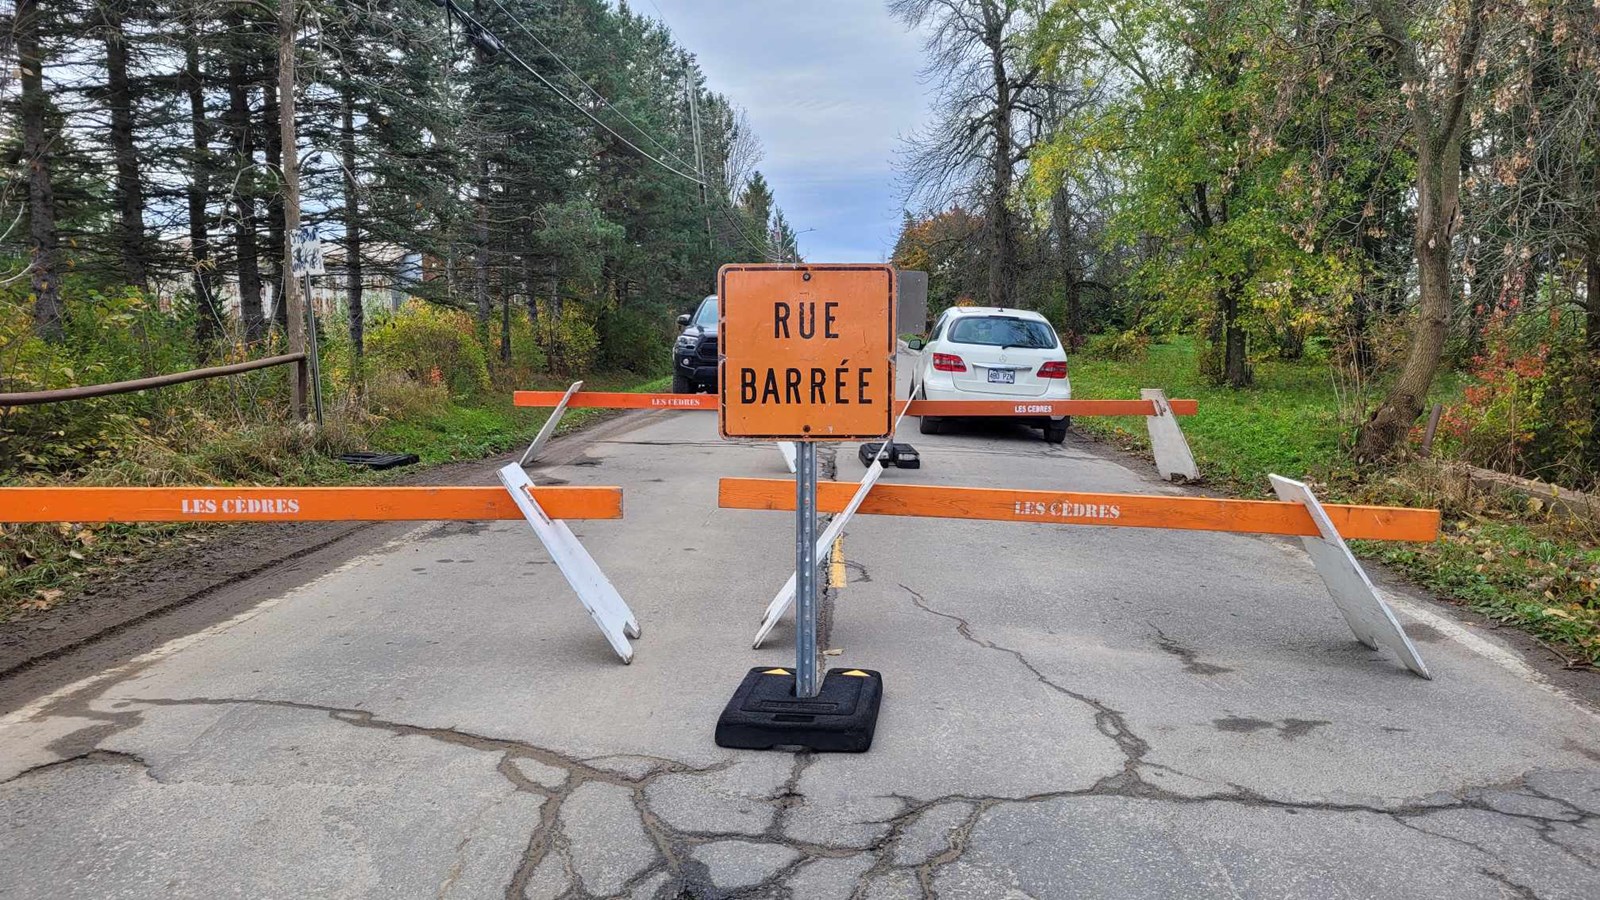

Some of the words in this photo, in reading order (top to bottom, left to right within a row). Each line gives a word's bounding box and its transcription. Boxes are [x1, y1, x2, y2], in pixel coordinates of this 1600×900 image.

[774, 302, 839, 340] RUE
[740, 359, 872, 405] BARRÉE
[651, 398, 667, 406] LES
[1014, 405, 1026, 413] LES
[181, 499, 217, 514] LES
[221, 495, 300, 514] CÈDRES
[1014, 501, 1046, 515] LES
[1049, 500, 1121, 519] CÈDRES
